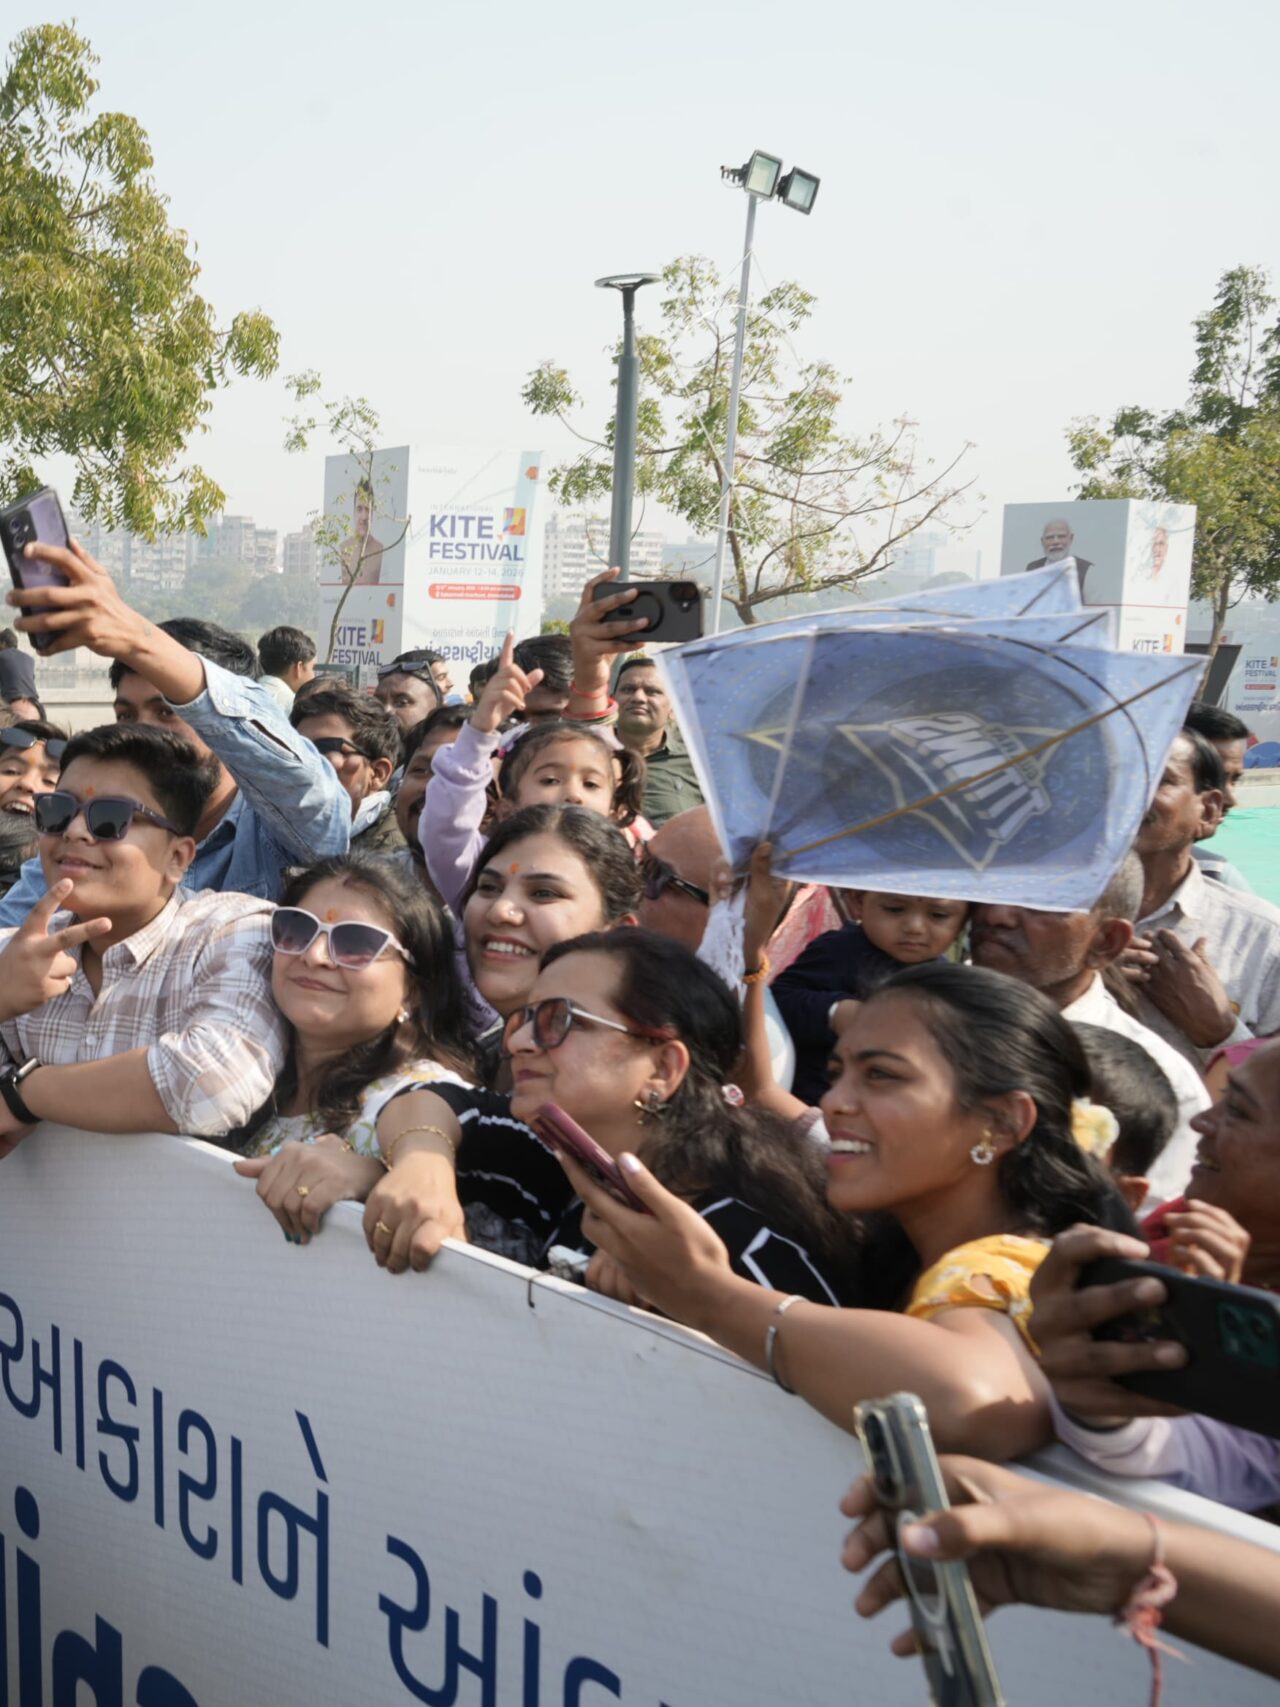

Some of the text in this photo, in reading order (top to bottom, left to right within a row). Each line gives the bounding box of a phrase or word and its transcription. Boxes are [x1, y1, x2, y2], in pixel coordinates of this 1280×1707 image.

[429, 514, 494, 539] KITE
[428, 542, 525, 562] FESTIVAL
[331, 648, 384, 667] FESTIVAL
